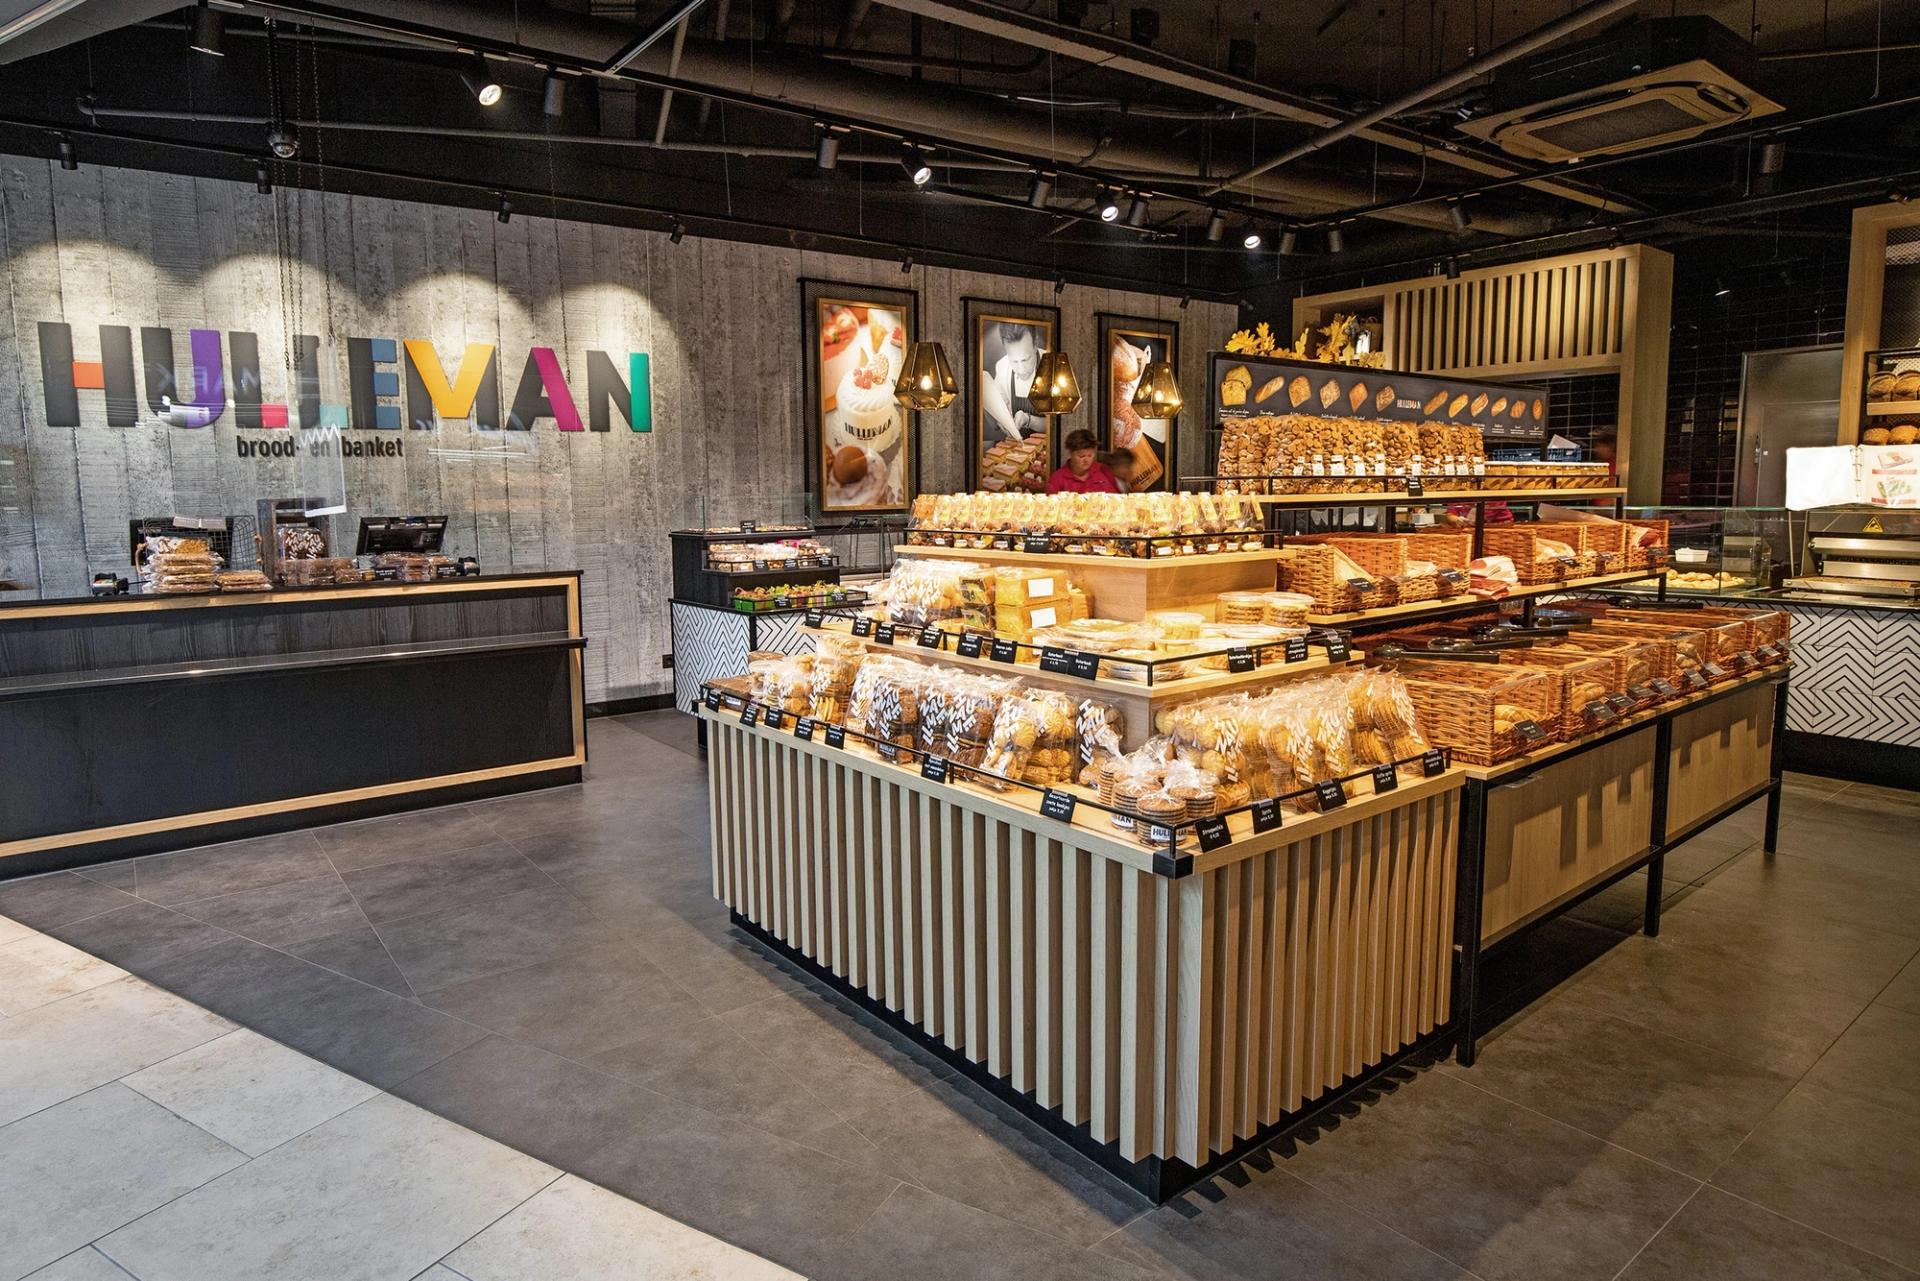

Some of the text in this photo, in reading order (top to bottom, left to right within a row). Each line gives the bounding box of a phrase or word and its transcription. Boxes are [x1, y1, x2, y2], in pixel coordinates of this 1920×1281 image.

[37, 321, 652, 432] HULLEMAN
[310, 439, 330, 457] en
[341, 436, 403, 457] banket
